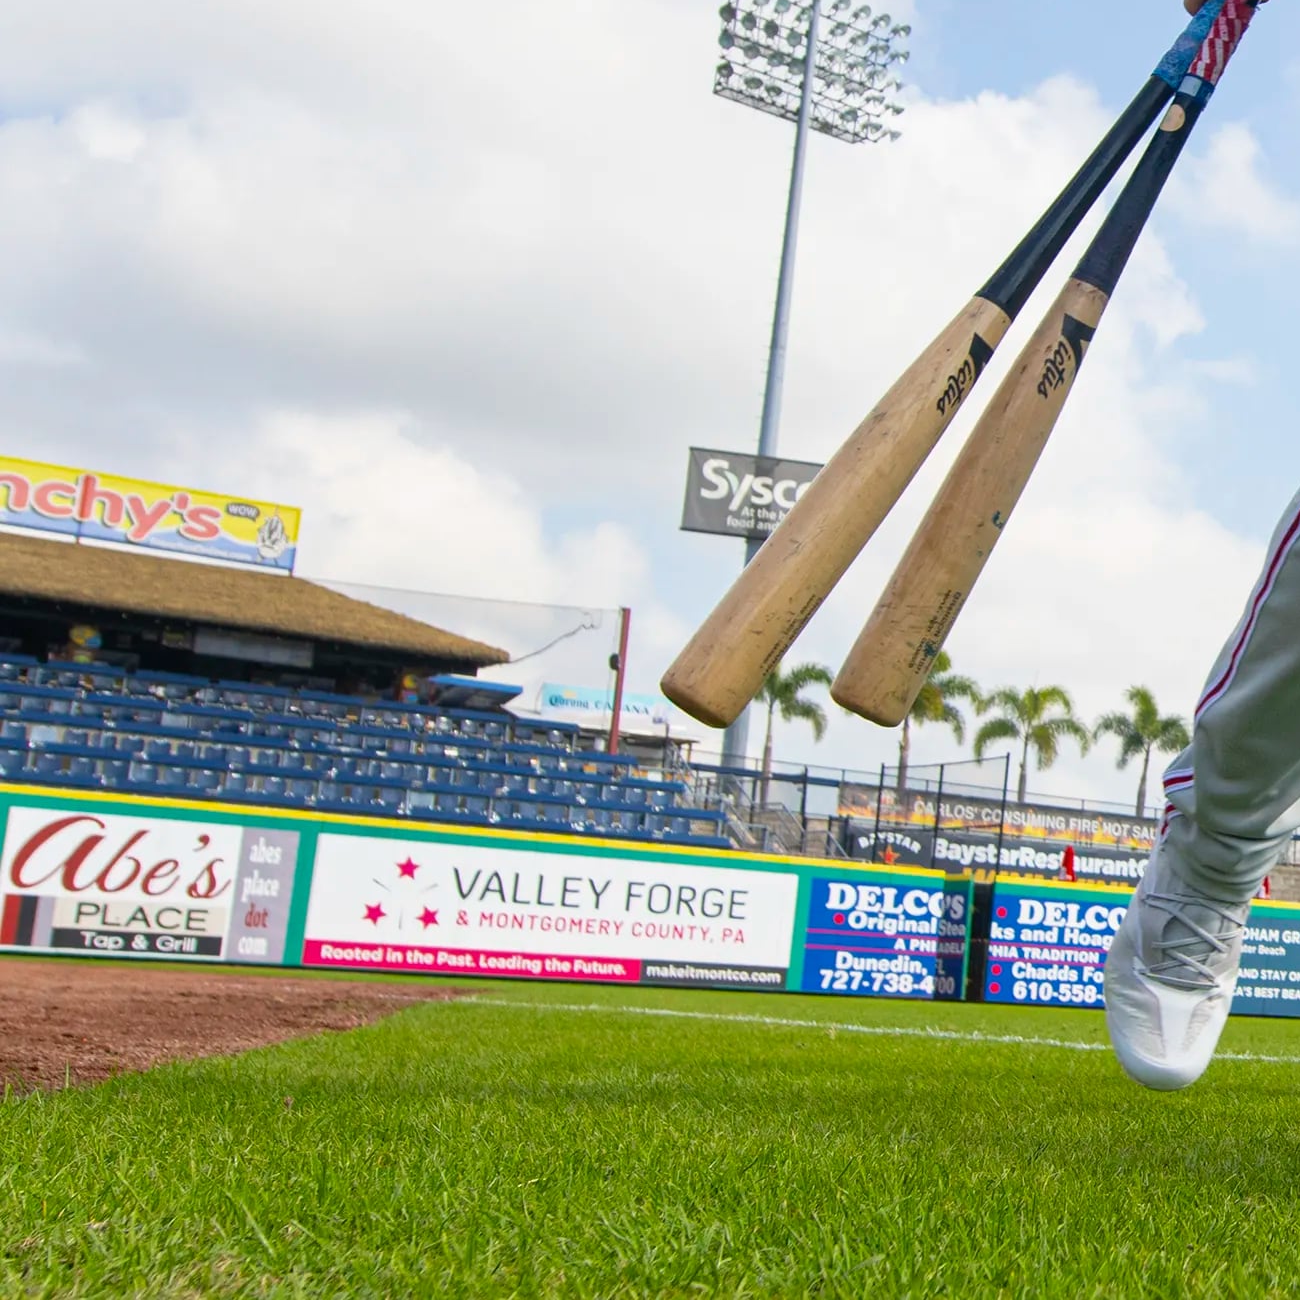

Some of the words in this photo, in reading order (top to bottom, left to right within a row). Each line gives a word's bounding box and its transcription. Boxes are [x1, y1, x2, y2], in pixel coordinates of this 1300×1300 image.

[1038, 313, 1096, 399] Victus
[936, 332, 994, 416] Victus
[227, 503, 258, 518] WOW
[726, 515, 754, 528] food
[757, 508, 777, 519] the
[594, 702, 649, 715] CAANA
[913, 799, 977, 821] CARLOS'
[981, 808, 1066, 831] CONSUMING
[1069, 816, 1099, 835] FIRE
[1102, 820, 1131, 838] HOT
[249, 837, 282, 865] abes
[857, 831, 921, 855] BAYSTAR
[10, 815, 231, 899] Abe's
[242, 869, 280, 902] place
[452, 866, 612, 911] VALLEY
[625, 881, 749, 921] FORGE
[74, 902, 209, 932] PLACE
[244, 903, 268, 929] dot
[456, 909, 469, 927] &
[479, 911, 624, 938] MONTGOMERY
[631, 921, 714, 944] COUNTY,
[721, 926, 746, 945] PA
[848, 910, 937, 936] Original
[80, 931, 124, 951] Tap
[131, 933, 149, 950] &
[155, 935, 197, 952] Grill
[894, 938, 907, 949] A
[990, 921, 1015, 940] ks
[1020, 926, 1058, 943] and
[237, 935, 269, 956] com
[1022, 947, 1100, 963] TRADITION
[1258, 945, 1286, 956] Beach
[320, 945, 383, 963] Rooted
[386, 948, 403, 964] in
[406, 949, 433, 966] the
[436, 951, 476, 969] Past.
[479, 954, 541, 975] Leading
[544, 957, 569, 974] the
[572, 958, 627, 977] Future.
[836, 951, 928, 977] Dunedin,
[1011, 961, 1079, 982] Chadds
[646, 963, 782, 984] makeitmontco.com
[1261, 969, 1288, 982] STAY
[1013, 980, 1106, 1003] 610-558-
[1254, 987, 1280, 999] BEST
